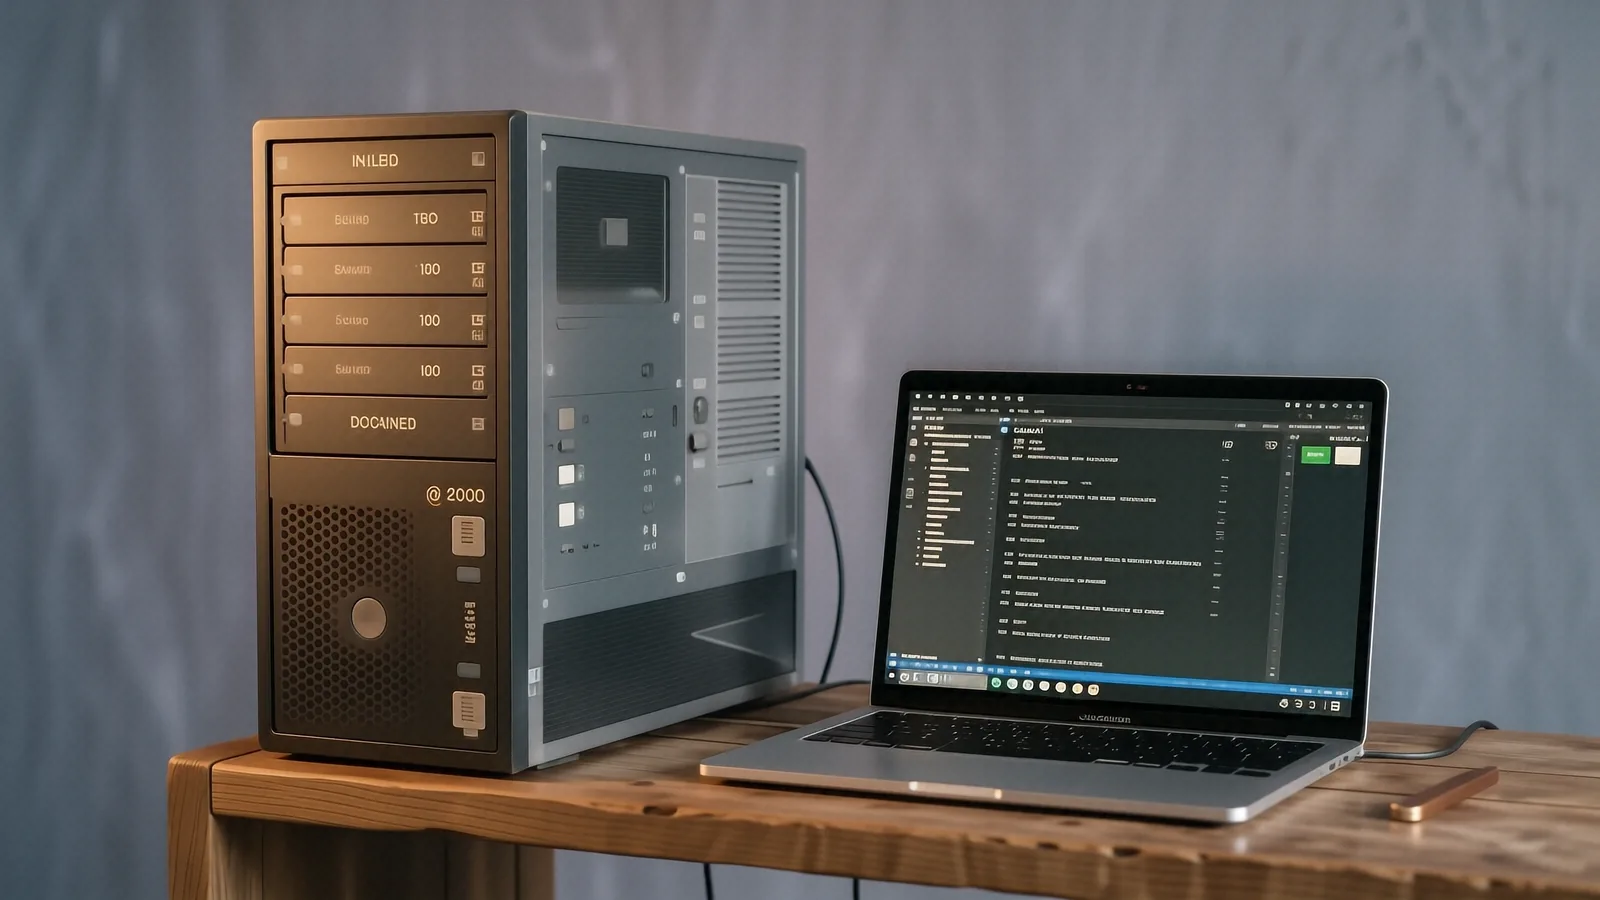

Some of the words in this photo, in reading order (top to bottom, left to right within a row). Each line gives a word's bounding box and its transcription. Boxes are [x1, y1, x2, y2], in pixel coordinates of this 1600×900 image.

[419, 314, 441, 327] 100
[350, 415, 417, 430] DOCAINED
[446, 487, 486, 503] 2000
